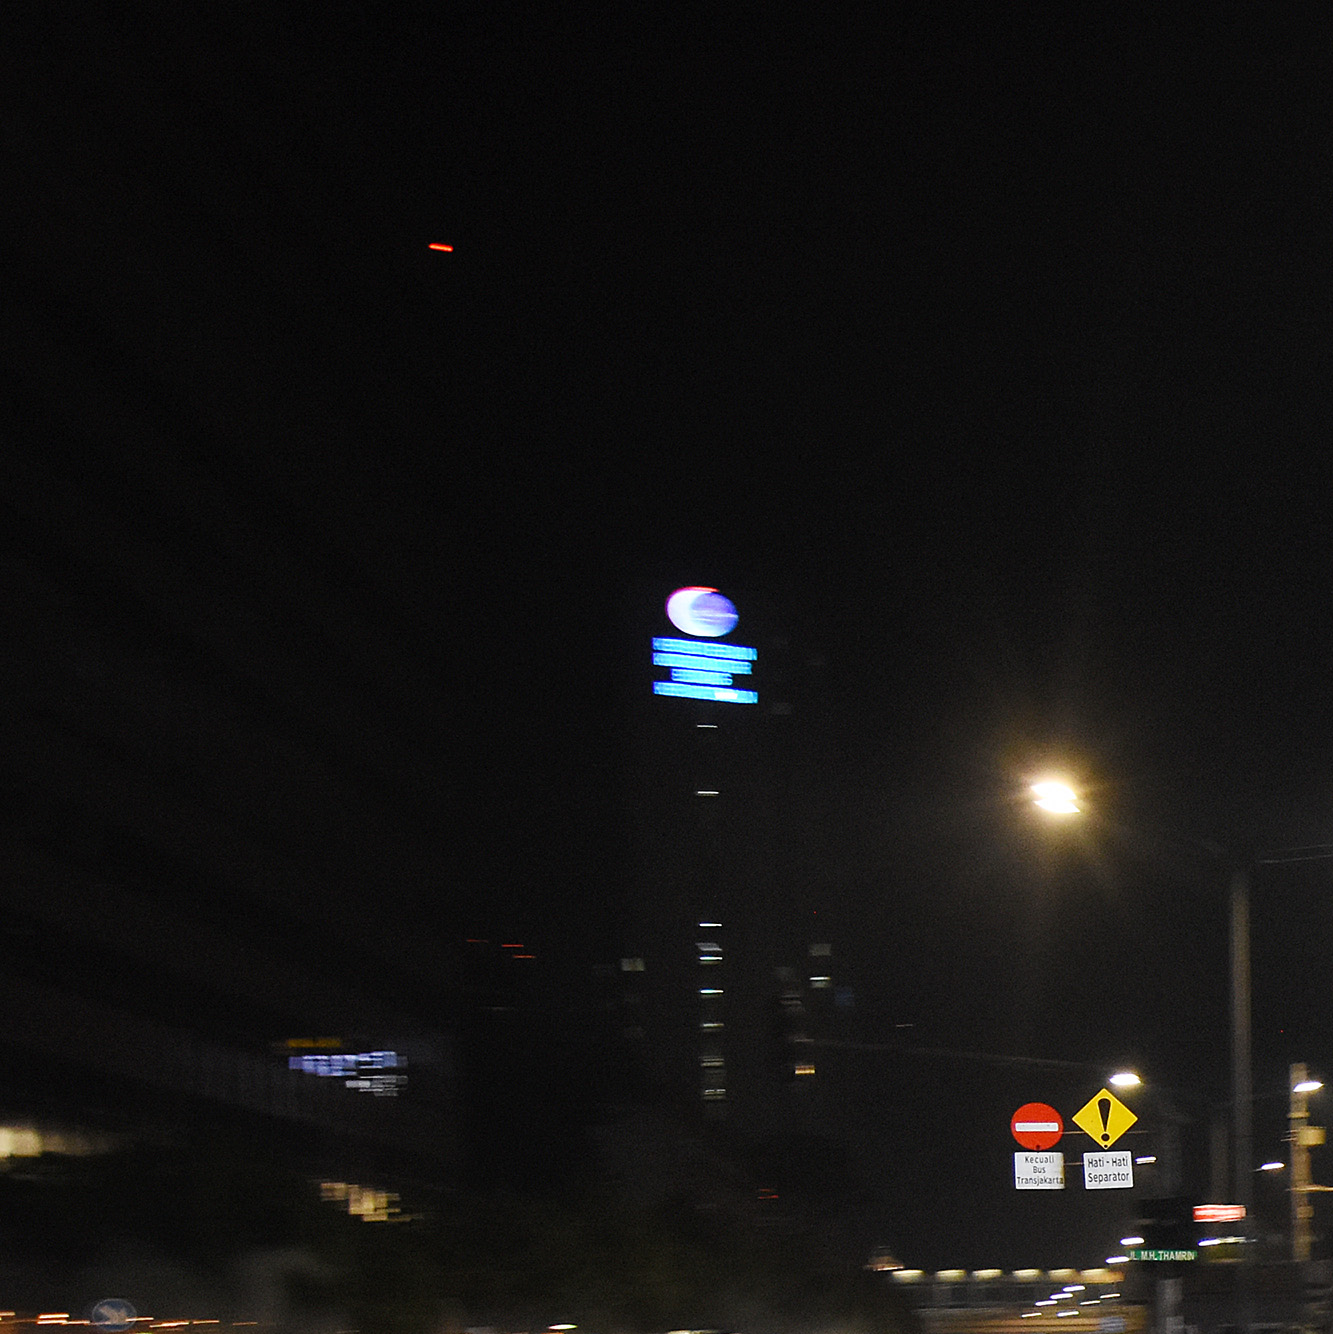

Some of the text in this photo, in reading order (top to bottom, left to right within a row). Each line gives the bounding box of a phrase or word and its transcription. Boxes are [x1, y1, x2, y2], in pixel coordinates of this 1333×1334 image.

[1024, 1155, 1055, 1164] Kecuali
[1087, 1157, 1105, 1168] Hati
[1111, 1156, 1128, 1167] Hati
[1032, 1165, 1046, 1174] Bus
[1017, 1176, 1064, 1186] Transjakarta
[1088, 1172, 1130, 1185] Separator
[1158, 1250, 1195, 1261] THAMRIN
